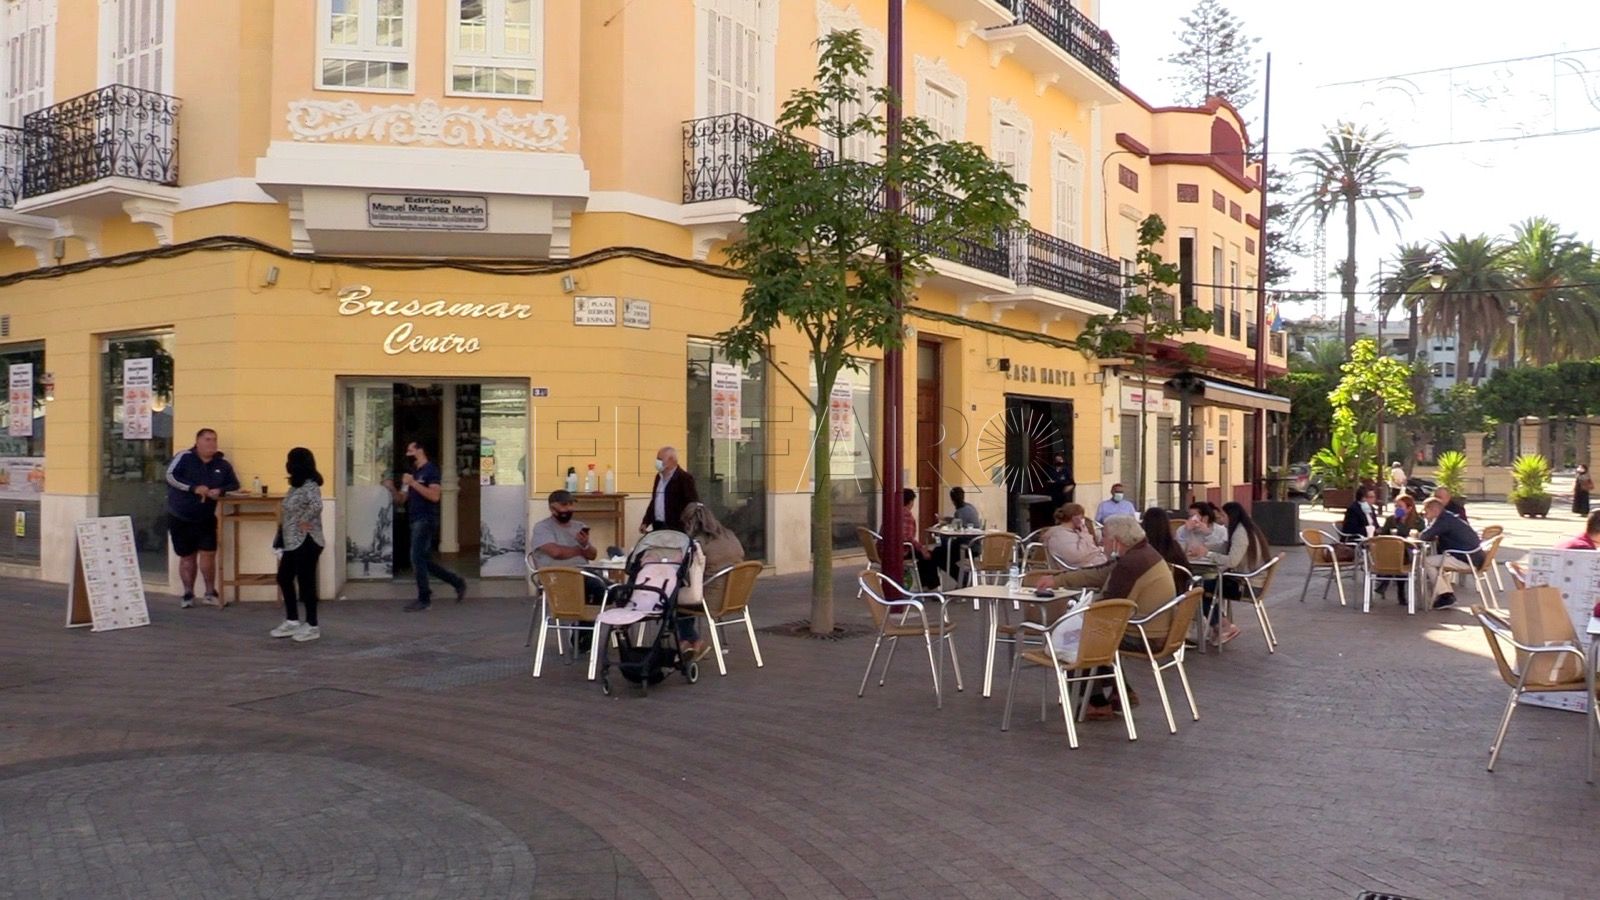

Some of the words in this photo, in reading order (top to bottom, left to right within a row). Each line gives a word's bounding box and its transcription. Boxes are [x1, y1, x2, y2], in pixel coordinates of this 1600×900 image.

[372, 203, 405, 212] Manuel
[405, 196, 451, 205] Edificio
[337, 284, 532, 319] Brisamar
[383, 322, 480, 355] Centro
